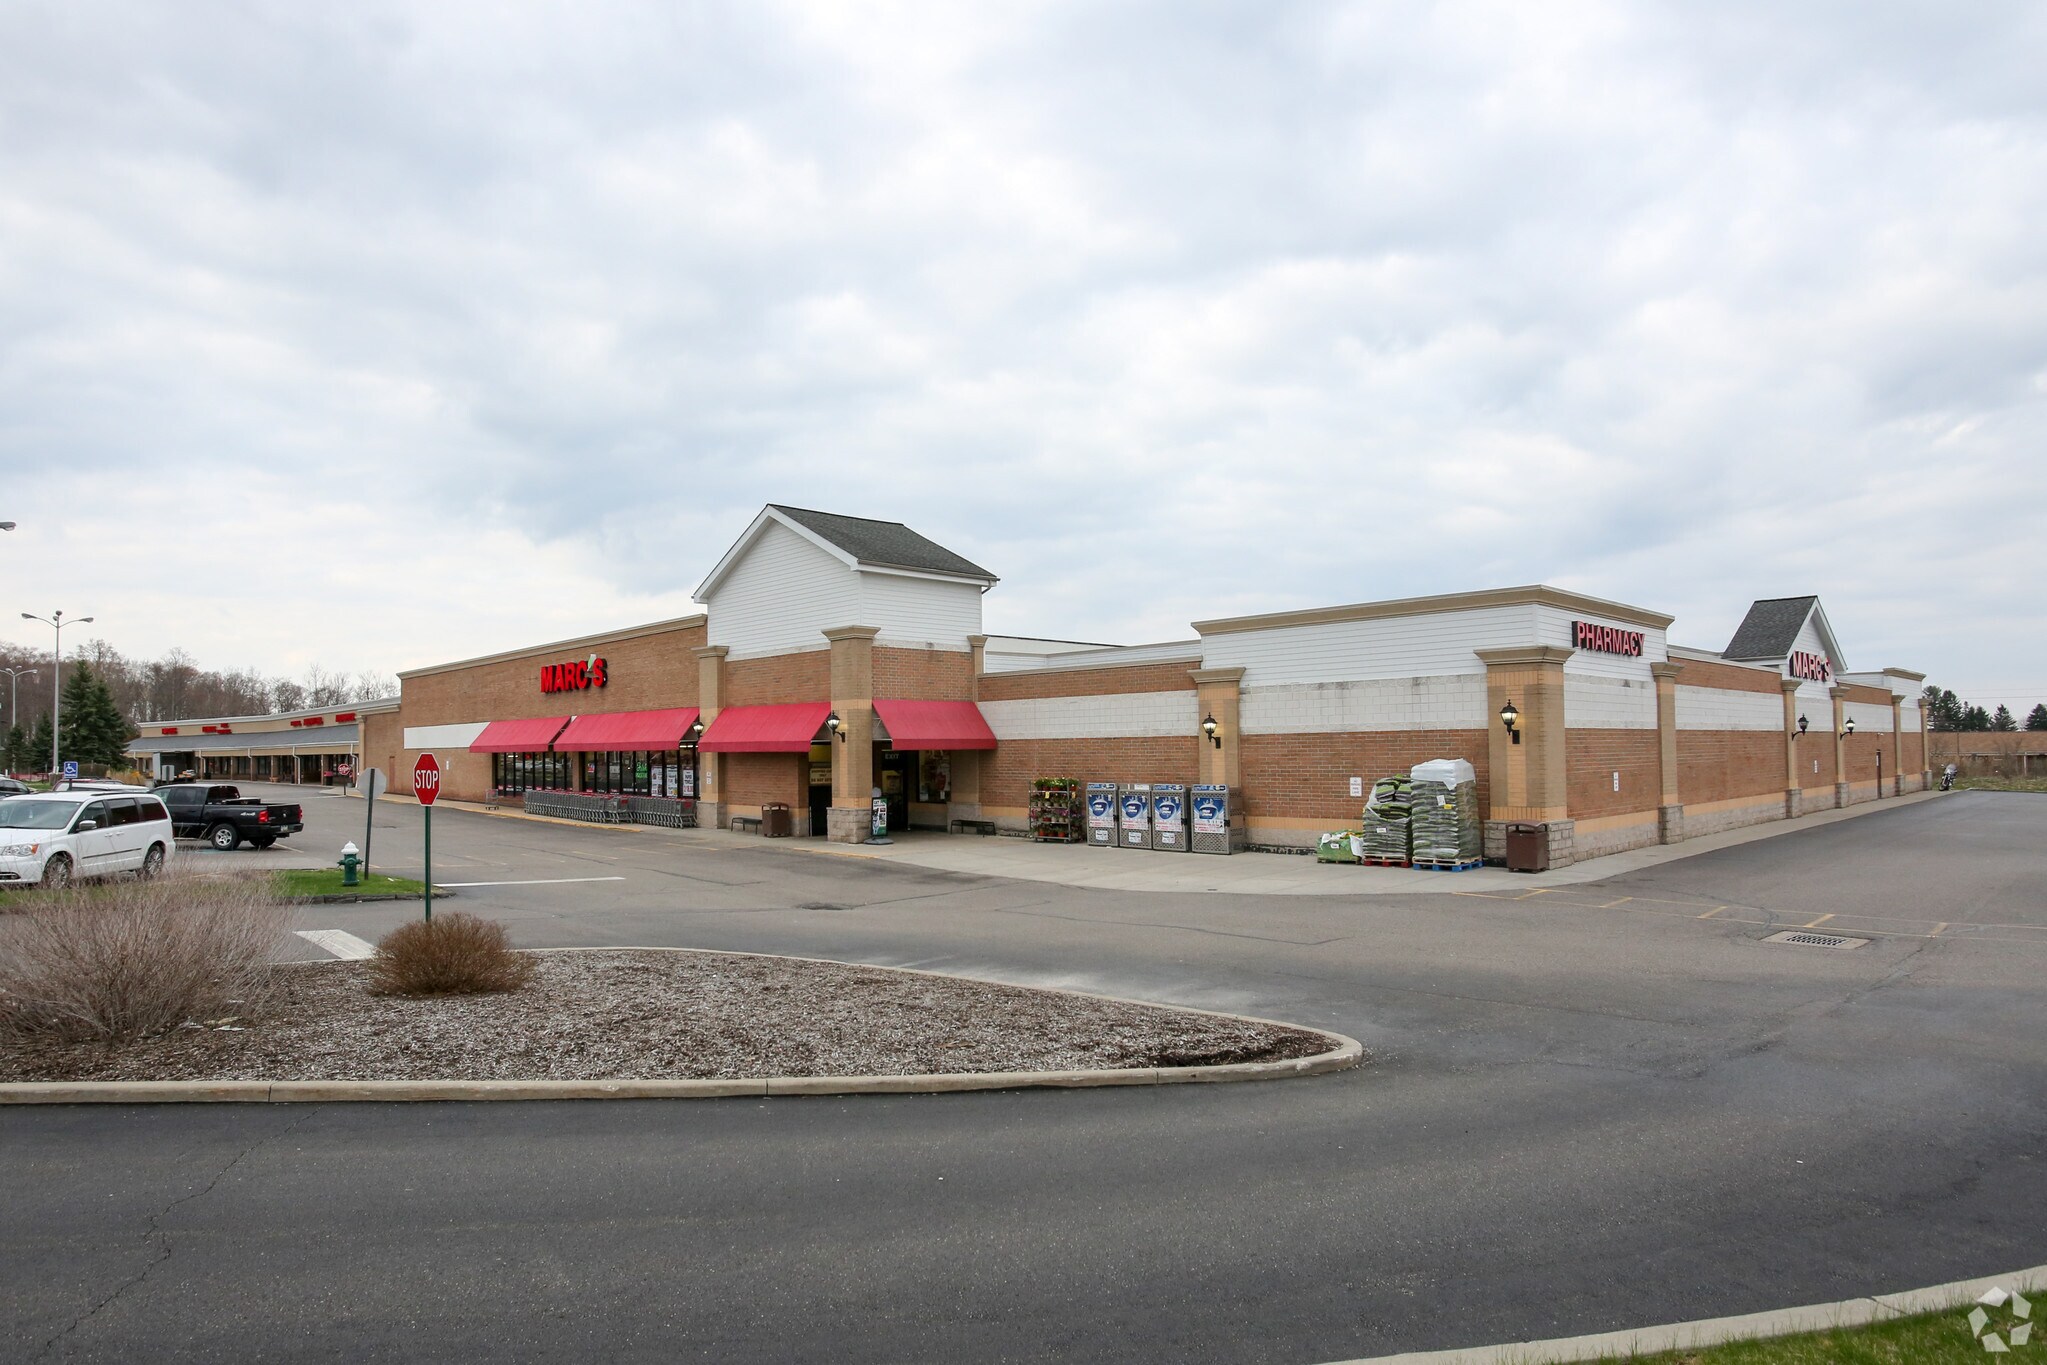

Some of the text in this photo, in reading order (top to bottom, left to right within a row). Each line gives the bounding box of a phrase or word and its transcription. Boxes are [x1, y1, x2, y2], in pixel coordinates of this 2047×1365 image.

[1577, 620, 1645, 656] PHARMACY
[541, 654, 606, 693] MARC'S
[1793, 650, 1832, 681] MARC'S
[415, 770, 439, 789] STOP
